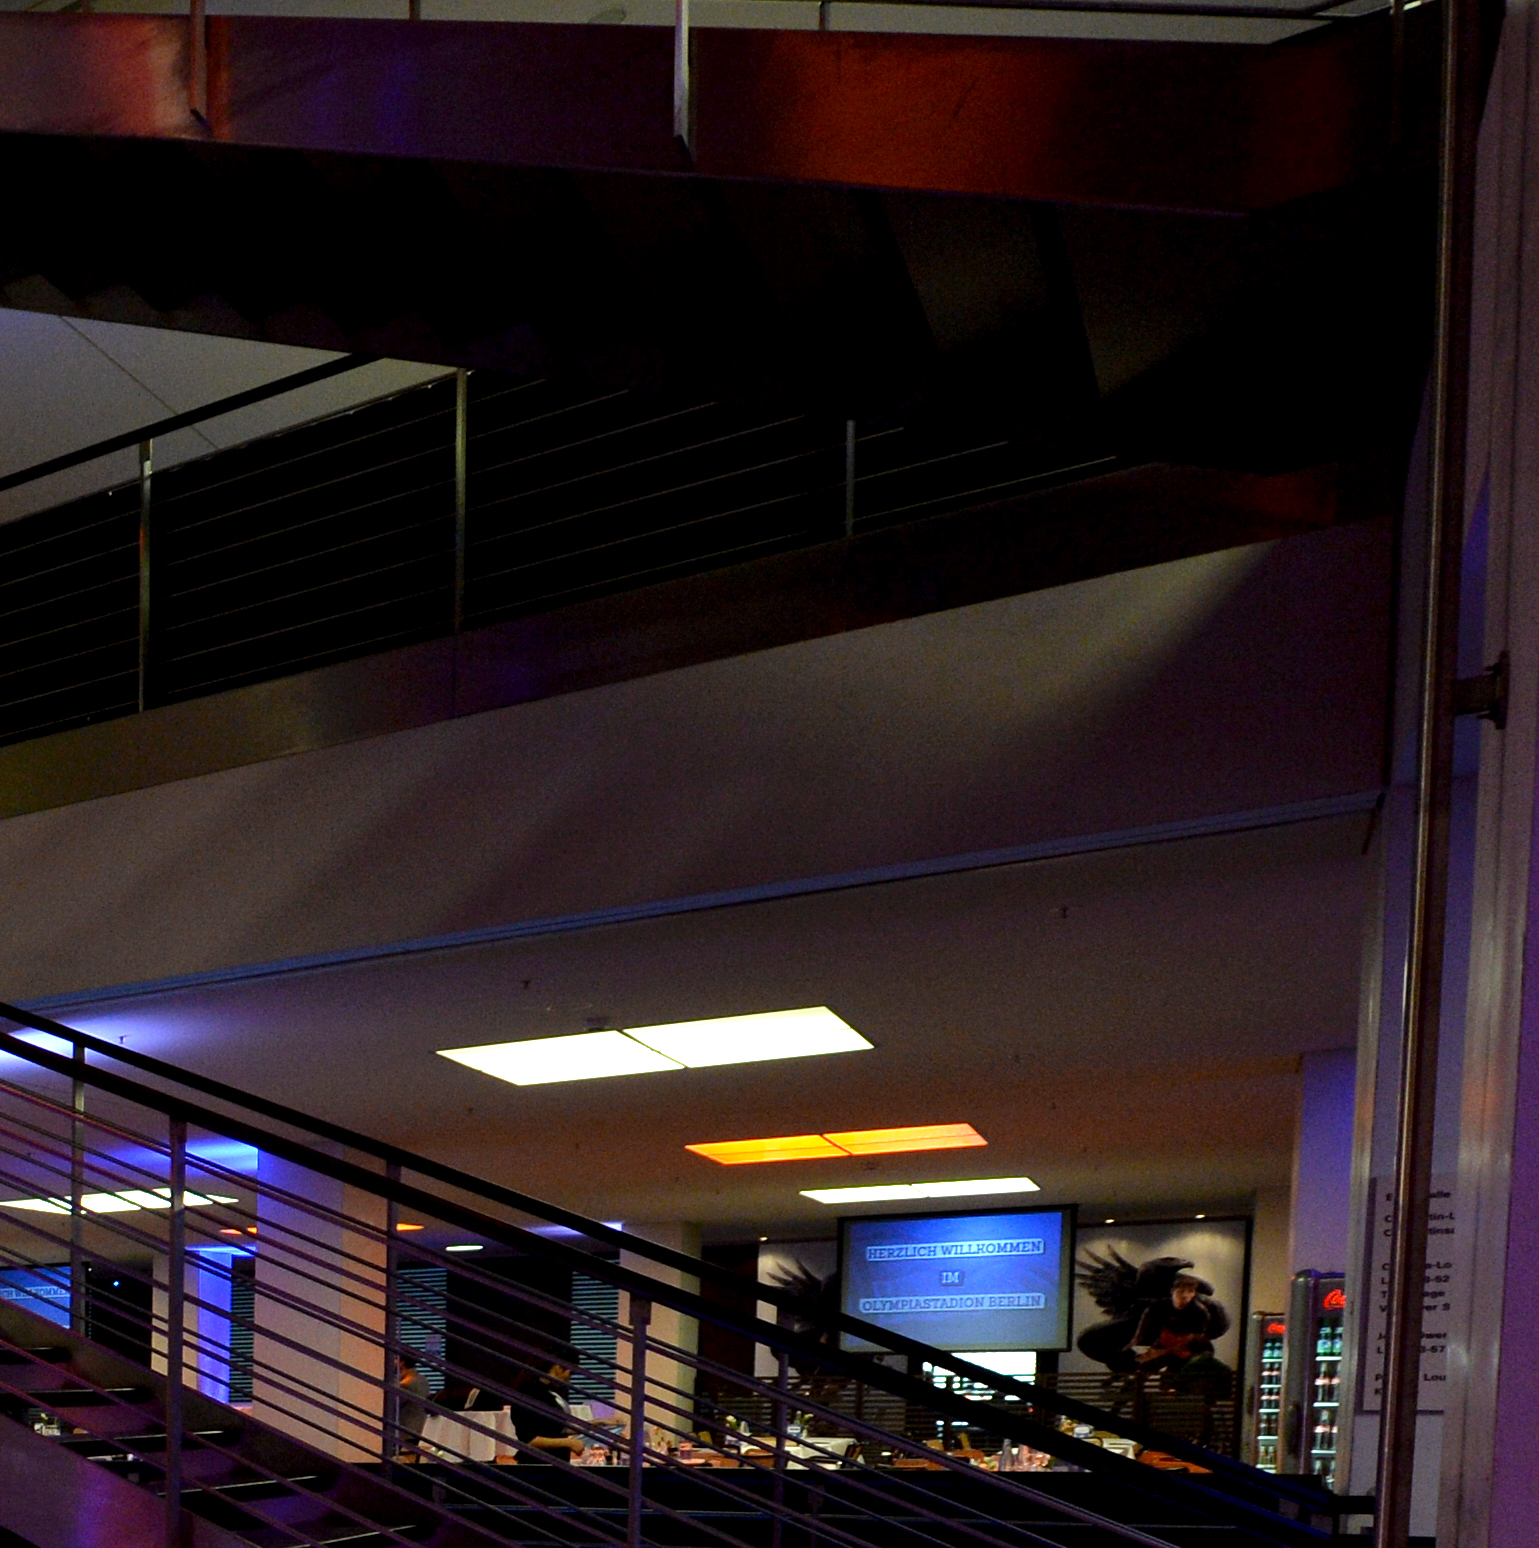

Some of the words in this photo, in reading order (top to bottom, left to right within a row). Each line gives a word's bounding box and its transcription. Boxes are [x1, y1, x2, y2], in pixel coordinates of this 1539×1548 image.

[867, 1245, 938, 1260] HERZLICH
[941, 1240, 1042, 1256] WILLKOMMEN
[941, 1272, 959, 1283] IM
[862, 1296, 985, 1312] OLYMPIASTADION
[988, 1294, 1042, 1309] BERLIN
